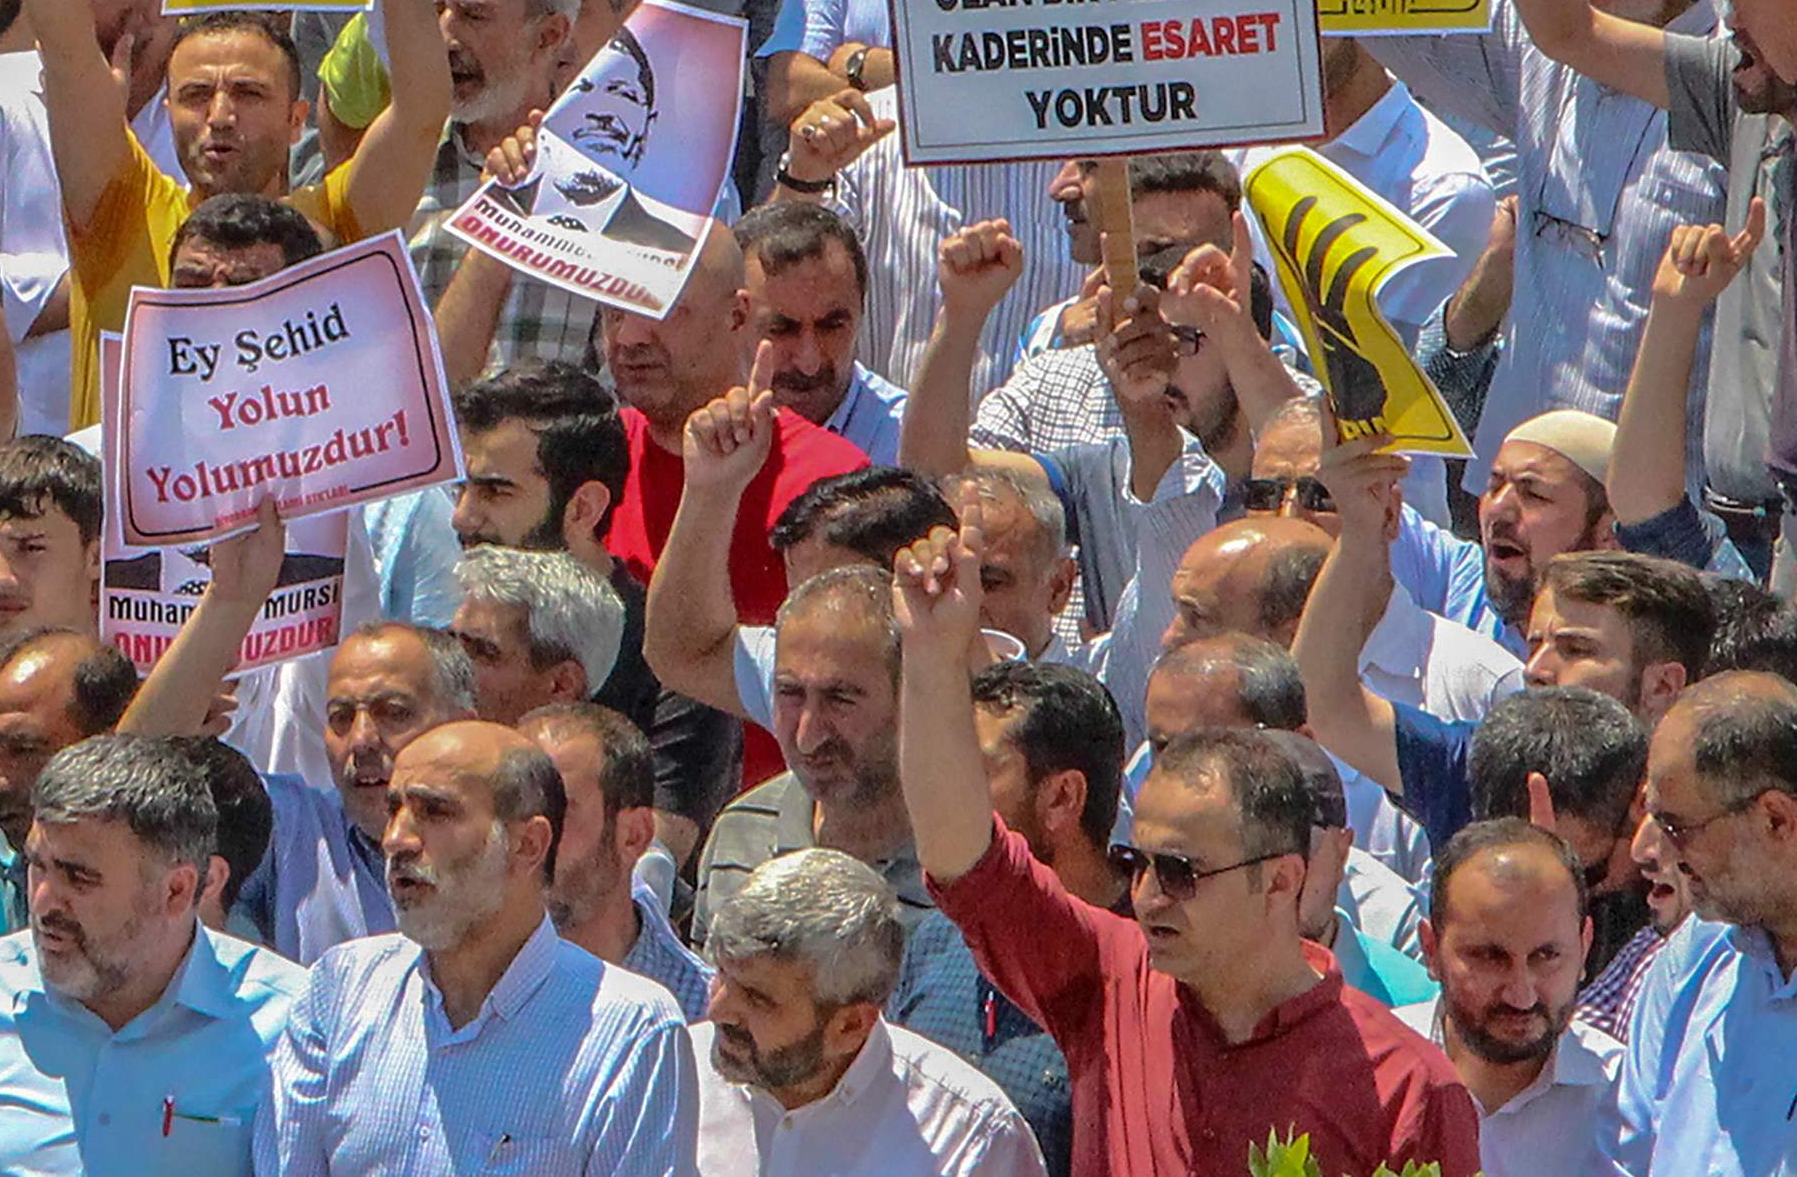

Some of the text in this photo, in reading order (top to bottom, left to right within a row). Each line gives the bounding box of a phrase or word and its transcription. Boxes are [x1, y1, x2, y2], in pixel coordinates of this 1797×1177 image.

[932, 13, 1281, 74] KADERİNDE ESARET
[1025, 82, 1198, 130] YOKTUR
[167, 302, 350, 381] Ey Şehid
[208, 383, 331, 430] Yolun
[146, 408, 410, 504] Yolumuzdur!
